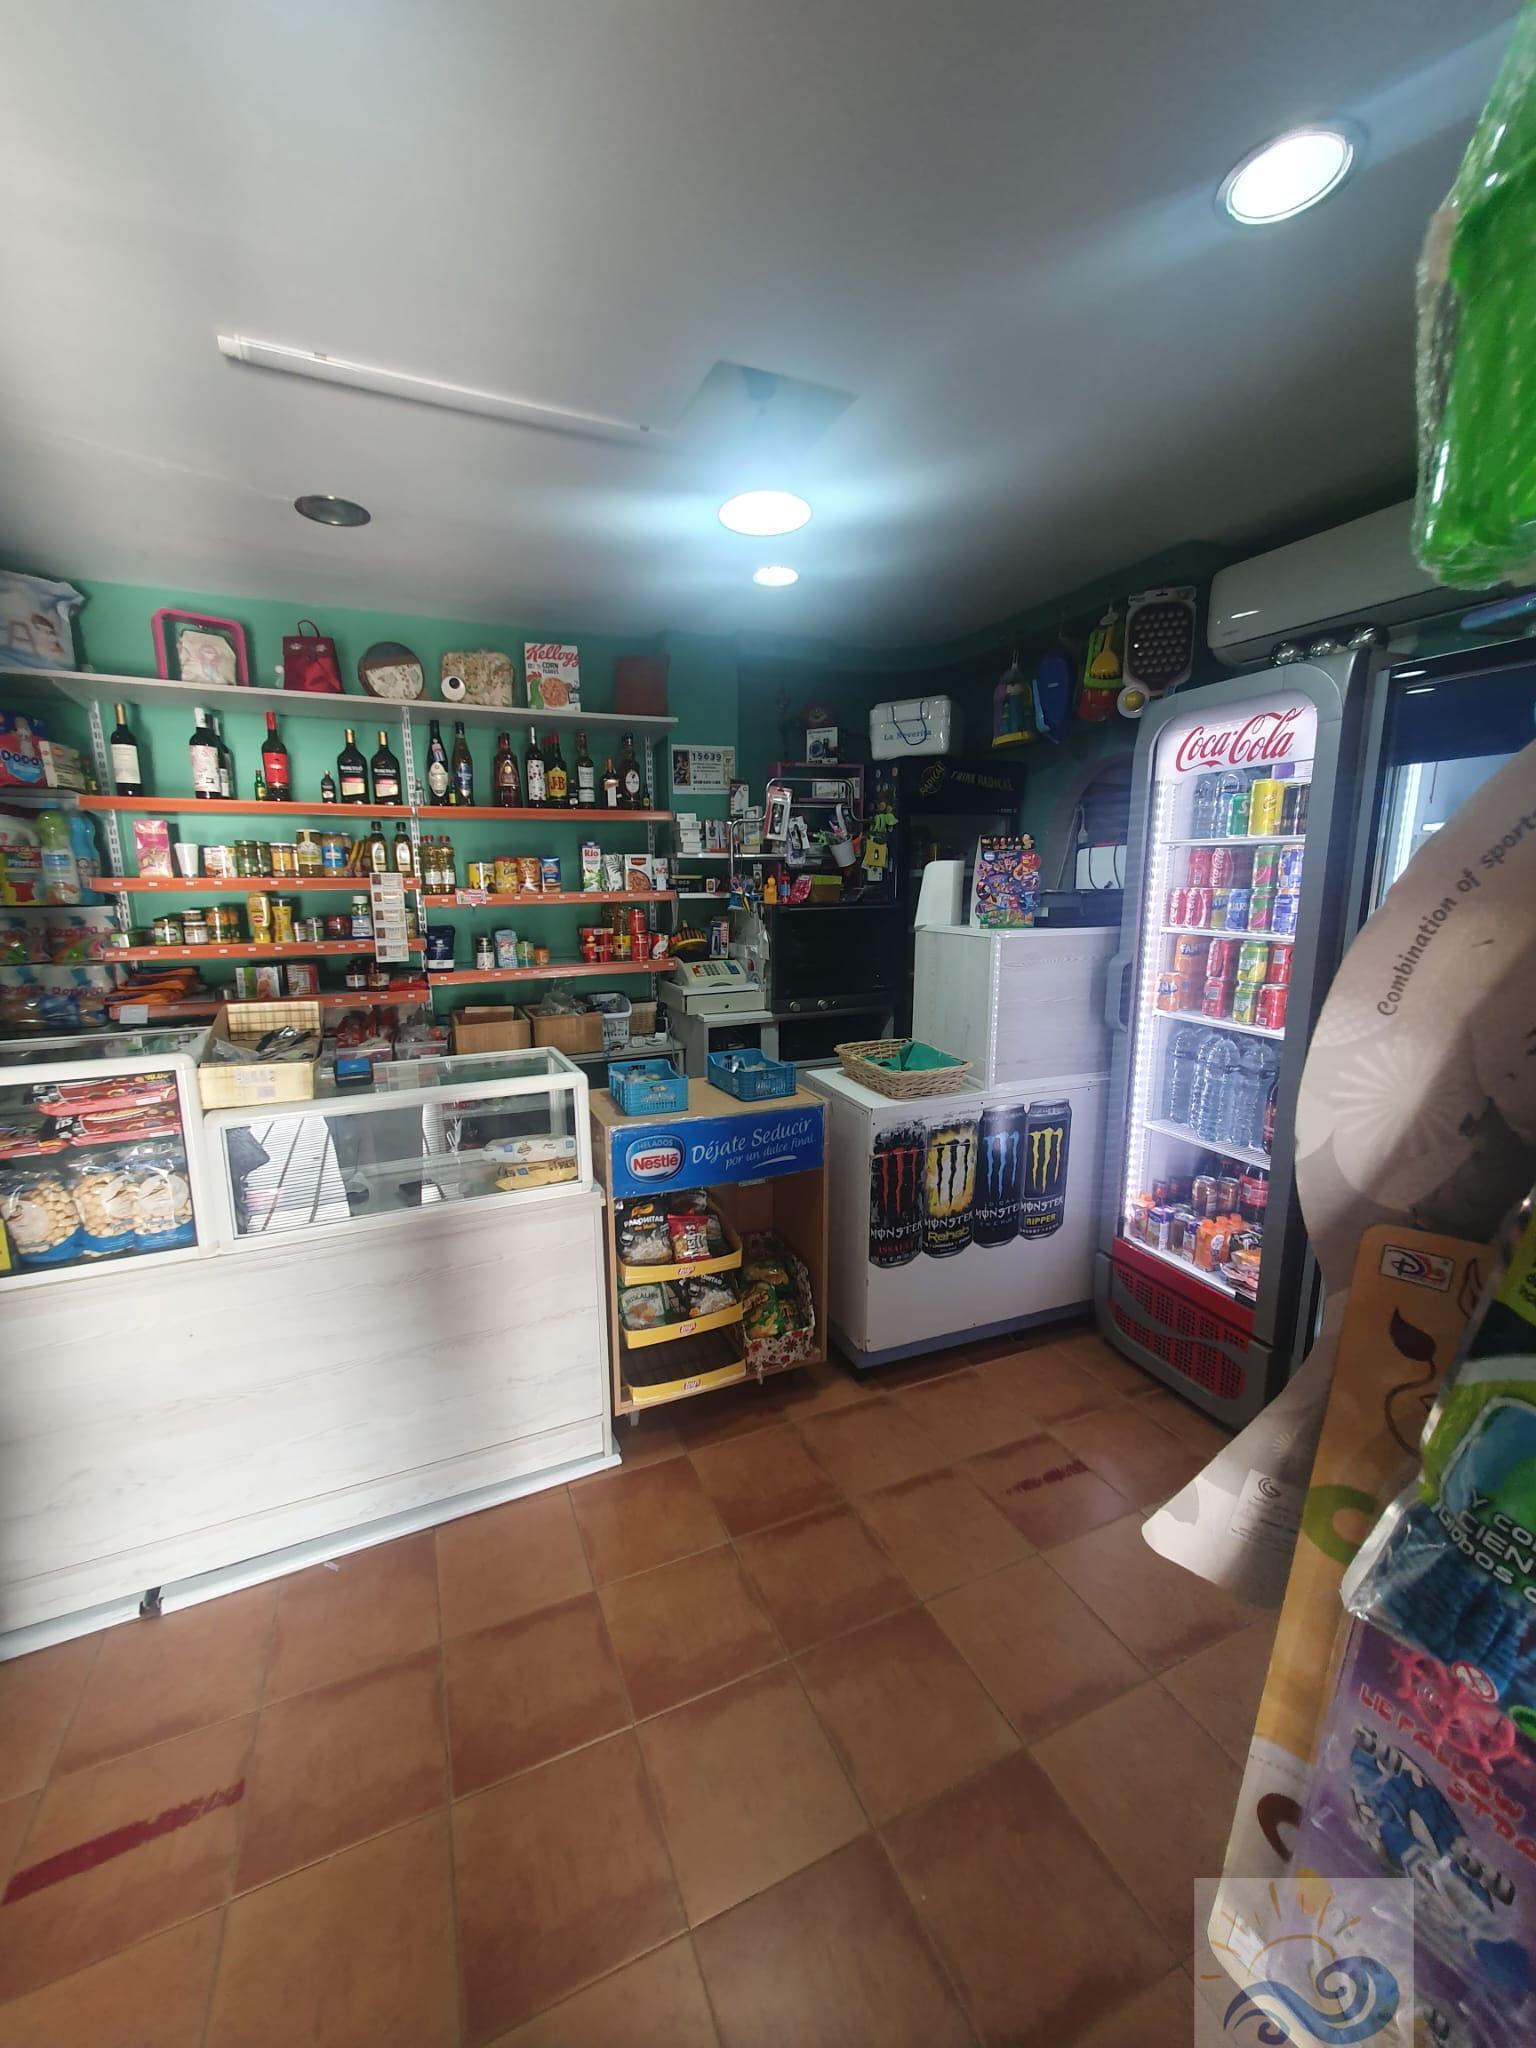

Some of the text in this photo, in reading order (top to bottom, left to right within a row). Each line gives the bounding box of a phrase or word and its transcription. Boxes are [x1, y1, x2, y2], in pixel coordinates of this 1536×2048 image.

[1176, 706, 1306, 772] Coca-Cola
[1377, 897, 1458, 1016] Combination
[1457, 868, 1482, 893] of
[637, 1139, 674, 1149] HELADOS
[691, 1118, 812, 1165] Déjate Seducir
[633, 1153, 680, 1171] Nestlé
[725, 1156, 744, 1171] por
[746, 1150, 761, 1162] un
[762, 1142, 788, 1158] dulce
[870, 1219, 923, 1241] MONSTER
[923, 1211, 974, 1230] MONSTER
[1024, 1214, 1057, 1226] RIPPER
[927, 1226, 970, 1243] Rehab
[1493, 1513, 1536, 1555] CO
